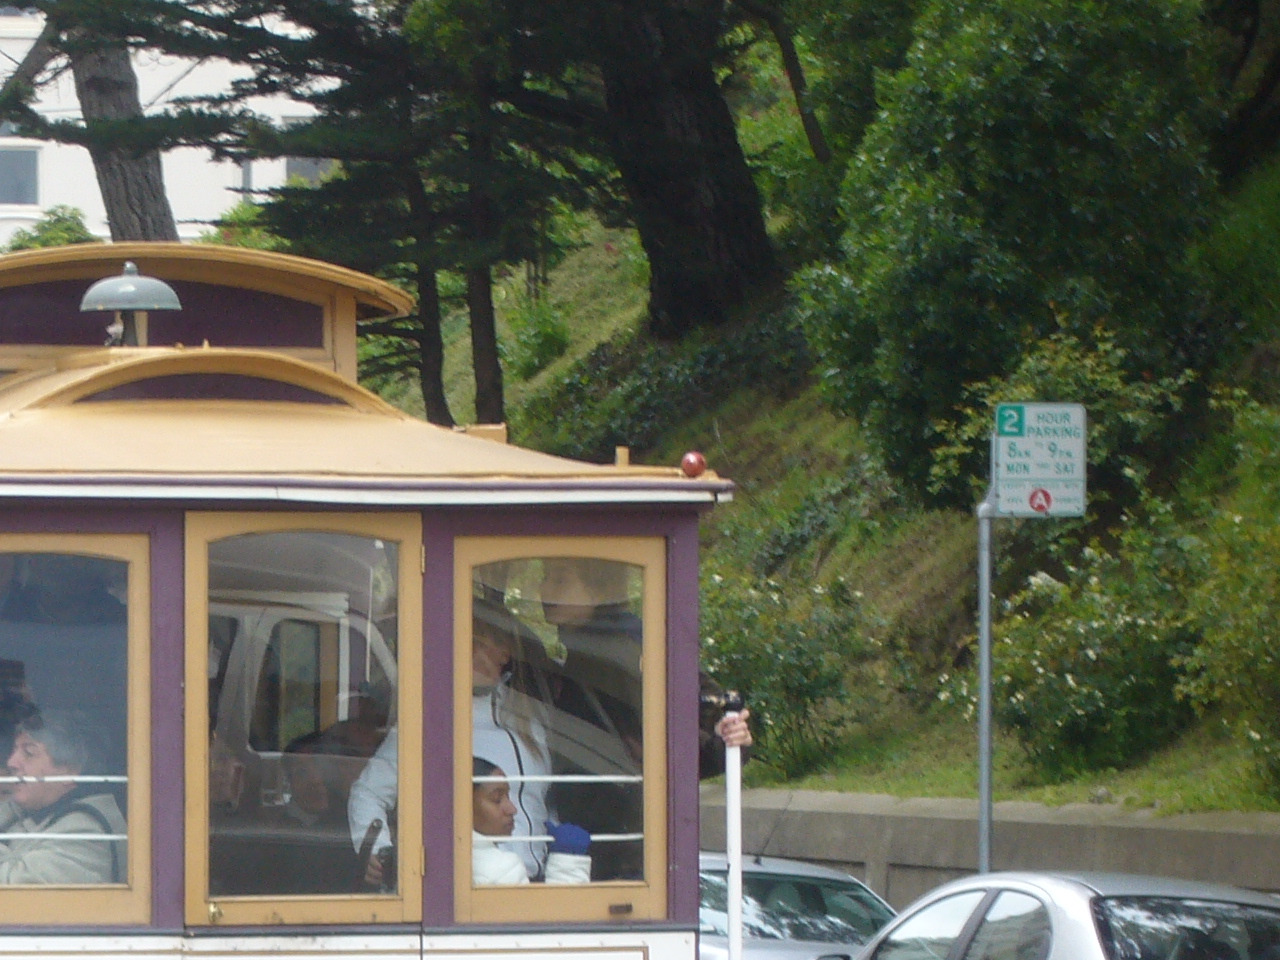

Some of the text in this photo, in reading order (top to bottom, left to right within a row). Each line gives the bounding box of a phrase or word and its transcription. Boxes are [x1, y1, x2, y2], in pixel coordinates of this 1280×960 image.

[1001, 409, 1019, 433] 2
[1036, 412, 1071, 424] HOUR
[1027, 426, 1081, 438] PARKING
[1006, 462, 1031, 475] MON
[1055, 462, 1076, 475] SAT
[1034, 490, 1049, 509] A
